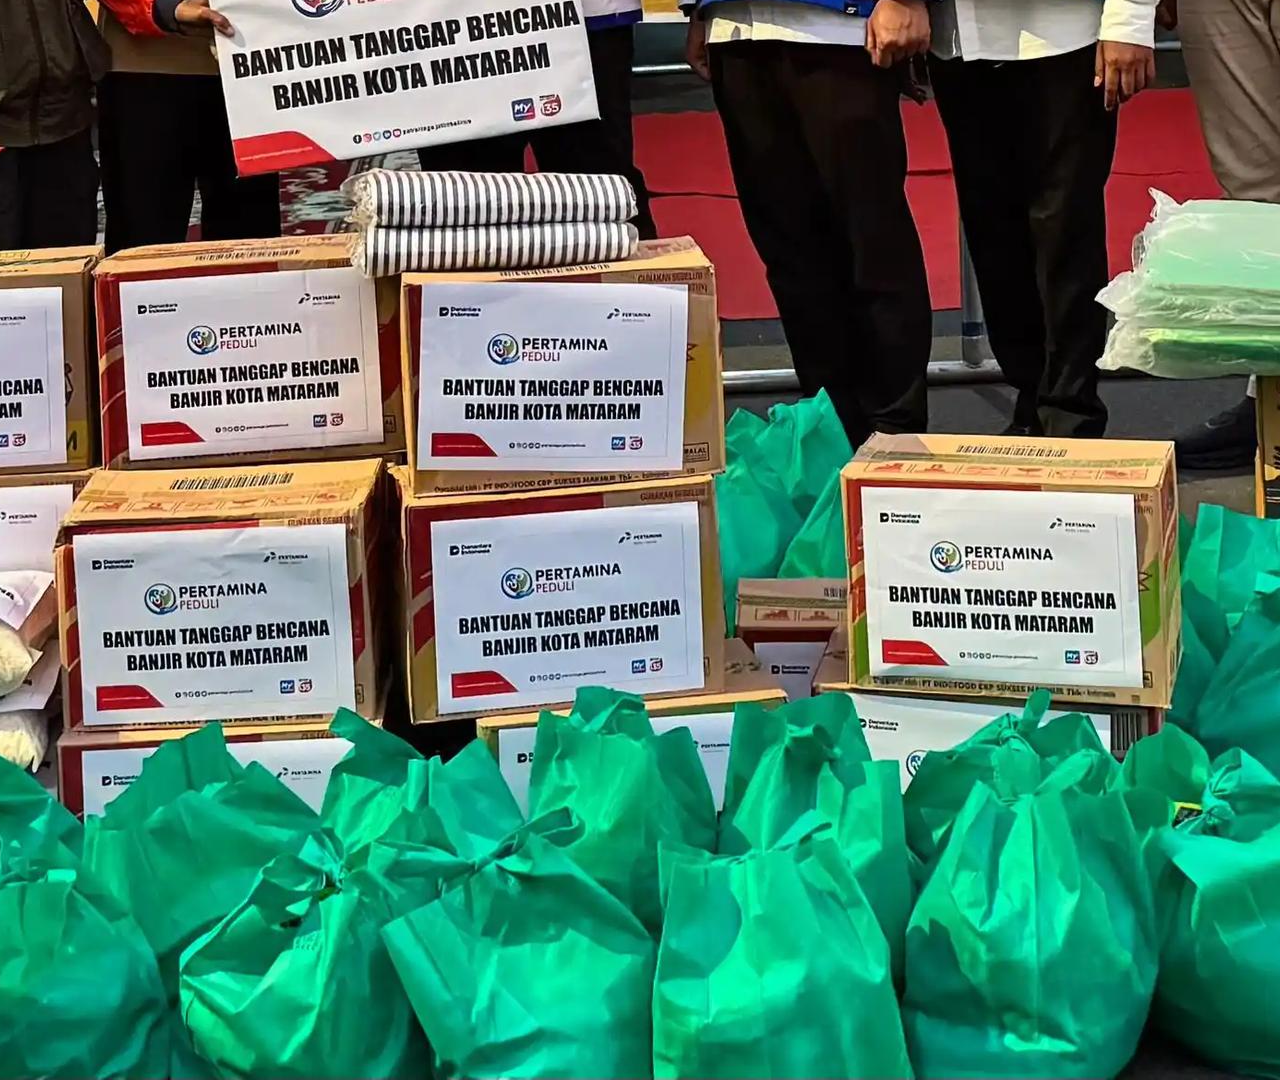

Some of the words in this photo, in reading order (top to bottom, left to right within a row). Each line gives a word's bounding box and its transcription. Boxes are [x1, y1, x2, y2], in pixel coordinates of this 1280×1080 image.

[232, 36, 347, 80] BANTUAN
[349, 18, 462, 64] TANGGAP
[465, 0, 581, 43] BENCANA
[272, 73, 360, 111] BANJIR
[362, 62, 428, 98] KOTA
[429, 41, 551, 86] MATARAM
[219, 322, 303, 339] PERTAMINA
[219, 338, 258, 350] PEDULI
[521, 337, 608, 351] PERTAMINA
[521, 351, 560, 363] PEDULI
[147, 367, 217, 388] BANTUAN
[219, 363, 288, 382] TANGGAP
[291, 357, 360, 378] BENCANA
[169, 389, 222, 410] BANJIR
[225, 386, 264, 405] KOTA
[266, 381, 340, 402] MATARAM
[442, 379, 516, 397] BANTUAN
[519, 379, 590, 397] TANGGAP
[593, 379, 664, 397] BENCANA
[464, 402, 519, 420] BANJIR
[522, 402, 563, 421] KOTA
[565, 402, 641, 420] MATARAM
[964, 544, 1054, 562] PERTAMINA
[535, 563, 622, 582] PERTAMINA
[964, 559, 1005, 571] PEDULI
[179, 581, 268, 599] PERTAMINA
[535, 580, 576, 594] PEDULI
[179, 599, 220, 611] PEDULI
[888, 585, 962, 606] BANTUAN
[964, 588, 1039, 608] TANGGAP
[1041, 590, 1118, 610] BENCANA
[458, 611, 532, 635] BANTUAN
[534, 606, 607, 629] TANGGAP
[609, 598, 682, 623] BENCANA
[912, 610, 969, 630] BANJIR
[970, 611, 1012, 631] KOTA
[1014, 613, 1095, 634] MATARAM
[102, 628, 177, 649] BANTUAN
[179, 624, 253, 645] TANGGAP
[255, 619, 330, 641] BENCANA
[481, 635, 538, 657] BANJIR
[540, 631, 581, 653] KOTA
[583, 624, 660, 650] MATARAM
[126, 652, 183, 672] BANJIR
[185, 650, 227, 669] KOTA
[229, 644, 309, 667] MATARAM
